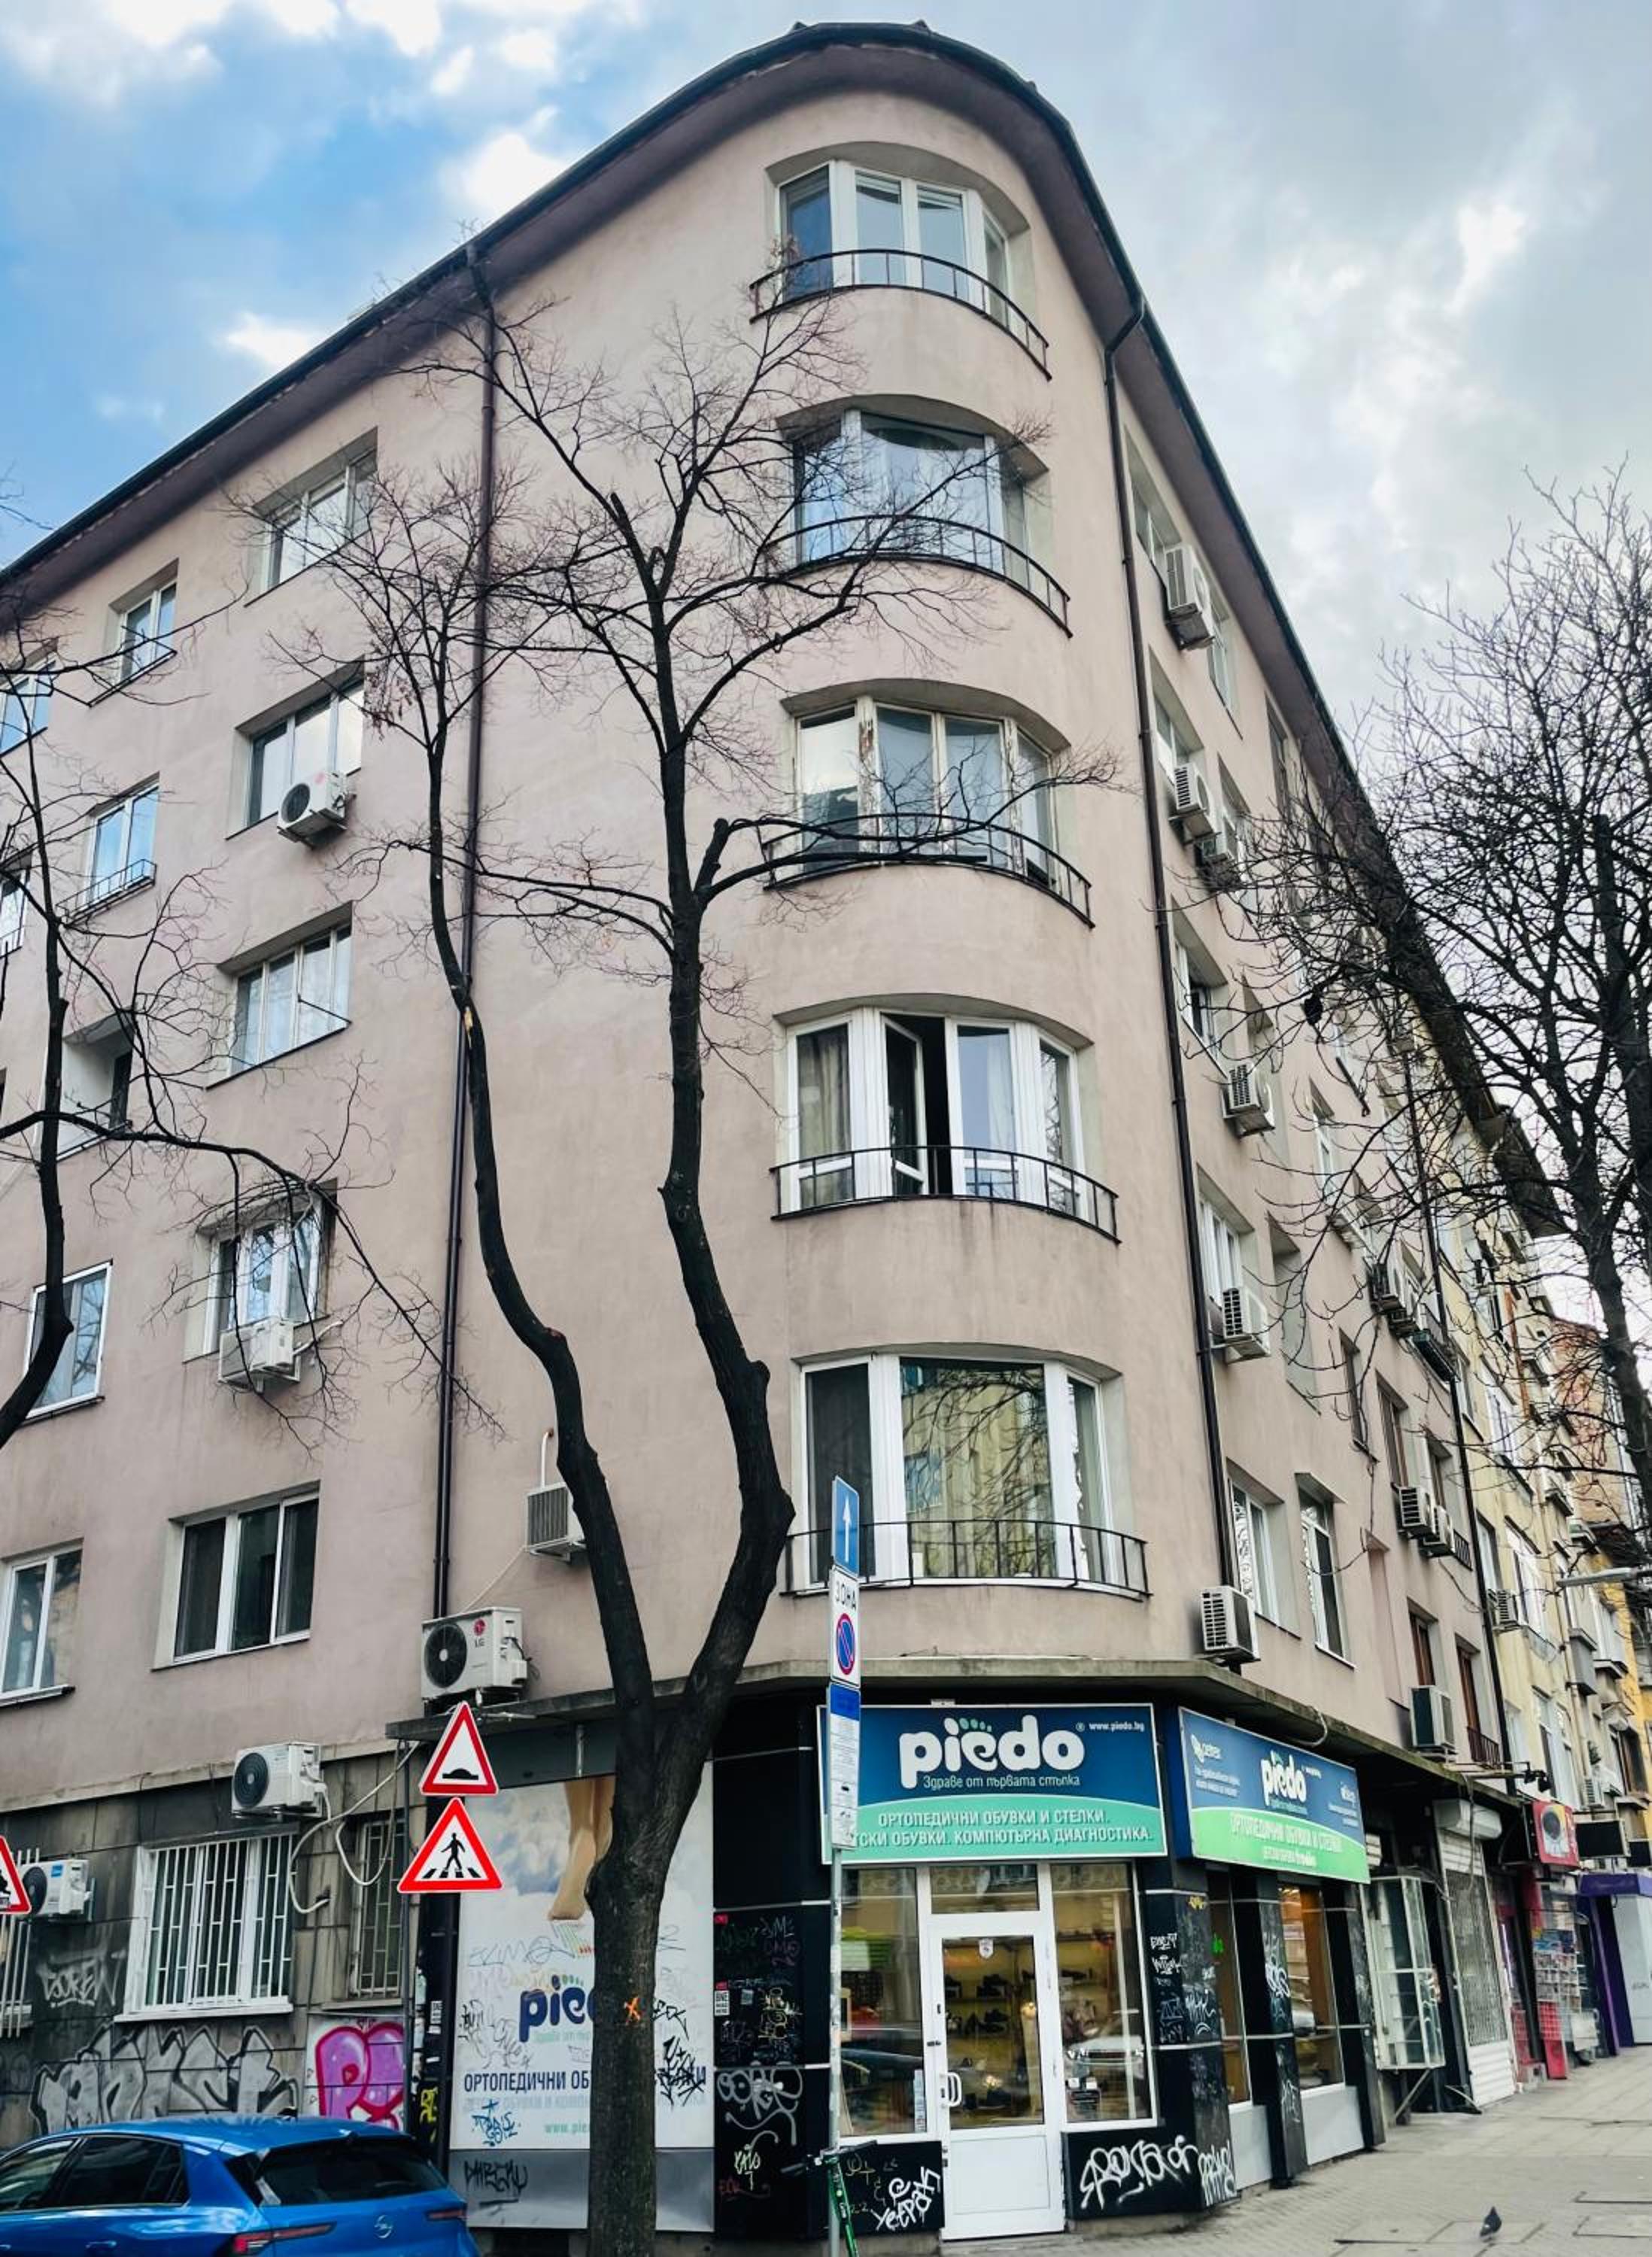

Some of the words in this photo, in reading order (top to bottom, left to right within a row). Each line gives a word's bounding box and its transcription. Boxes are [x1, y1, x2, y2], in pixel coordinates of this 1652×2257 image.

[1089, 1721, 1145, 1733] www.piedo.bg
[899, 1715, 1085, 1789] piedo
[923, 1776, 964, 1791] Здраве
[966, 1777, 984, 1788] от
[986, 1775, 1036, 1790] първата
[1039, 1773, 1080, 1788] стъпка
[1261, 1750, 1307, 1806] piedo
[879, 1810, 979, 1829] ОРТОПЕДИЧНИ
[983, 1809, 1037, 1825] ОБУВКИ
[1040, 1809, 1050, 1824] И
[954, 1828, 1052, 1845] КОМПЮТЪРНА
[519, 1975, 594, 2043] pie
[464, 2071, 566, 2094] ОРТОПЕДИЧНИ
